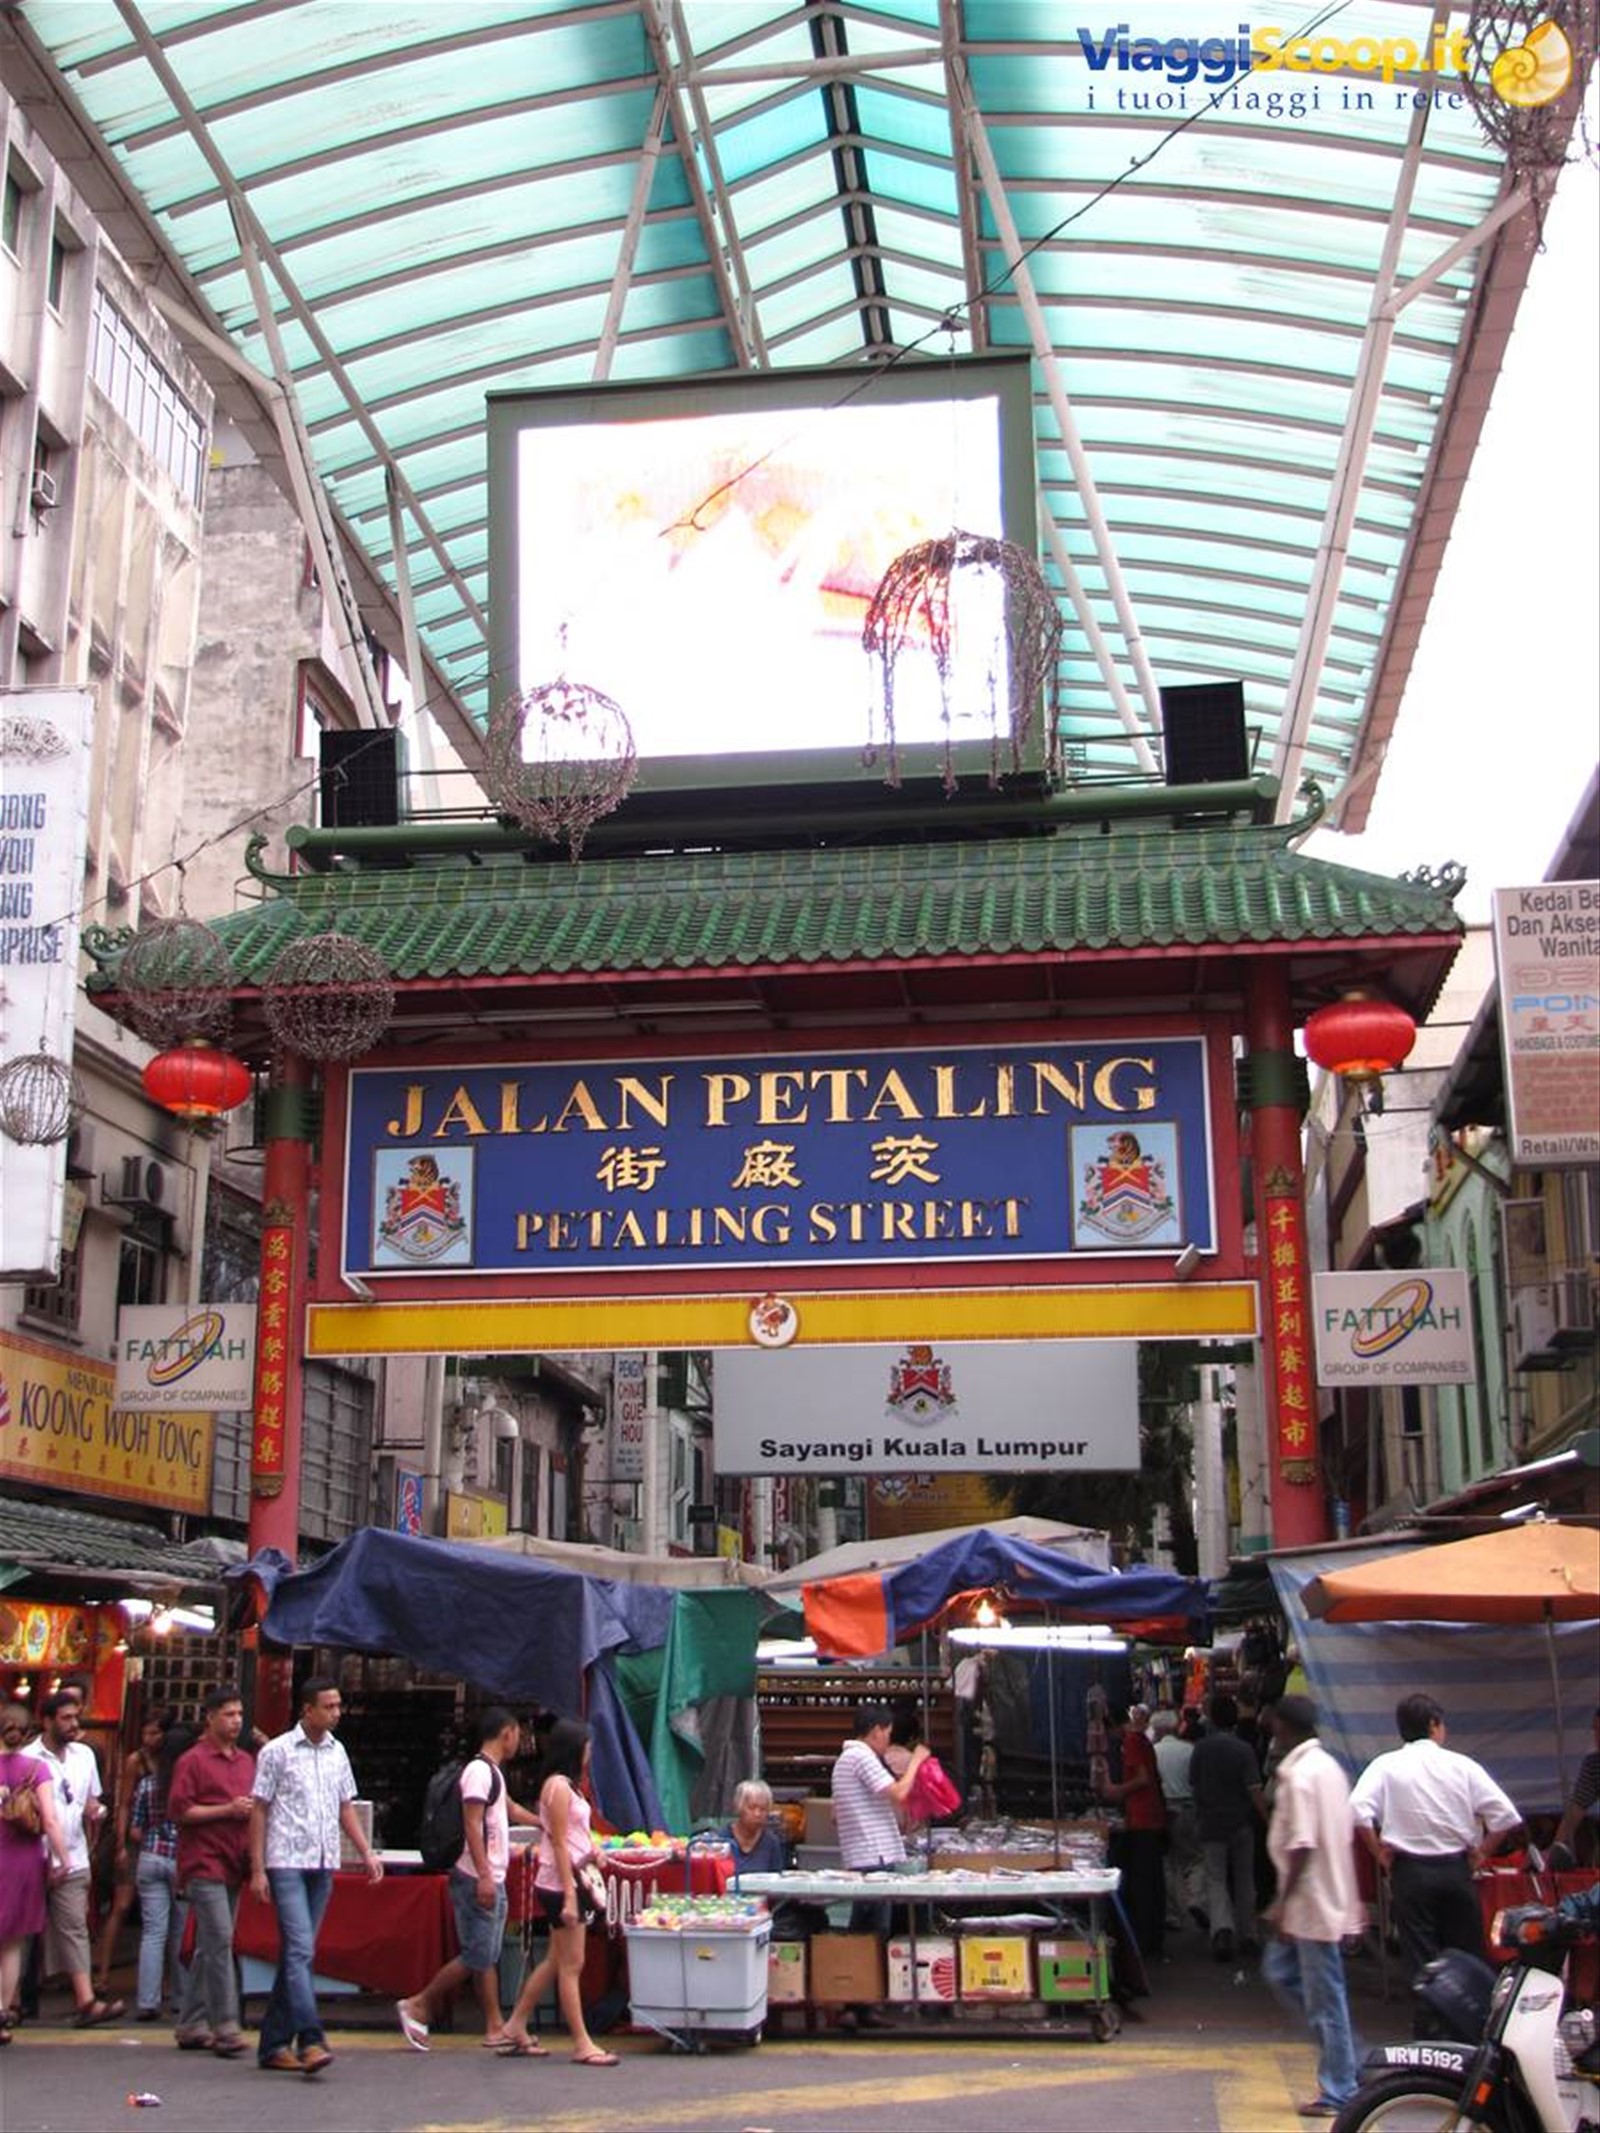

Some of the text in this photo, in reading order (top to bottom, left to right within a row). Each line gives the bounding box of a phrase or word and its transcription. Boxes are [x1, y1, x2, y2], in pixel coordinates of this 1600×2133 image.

[1519, 889, 1573, 912] Kedai
[1507, 915, 1544, 936] Dan
[1539, 935, 1600, 957] Wanita
[386, 1057, 1158, 1139] JALAN PETALING
[516, 1205, 791, 1252] PETALING
[808, 1199, 1029, 1243] STREET
[1324, 1360, 1468, 1376] GROUP OF COMPANIES
[121, 1390, 247, 1402] GROUP OF COMPANIES
[20, 1381, 96, 1443] KOONG
[104, 1404, 150, 1455] WOH
[157, 1419, 202, 1468] TONG
[760, 1438, 1088, 1461] Sayangi Kuala Lumpur
[1421, 2049, 1463, 2071] 5192
